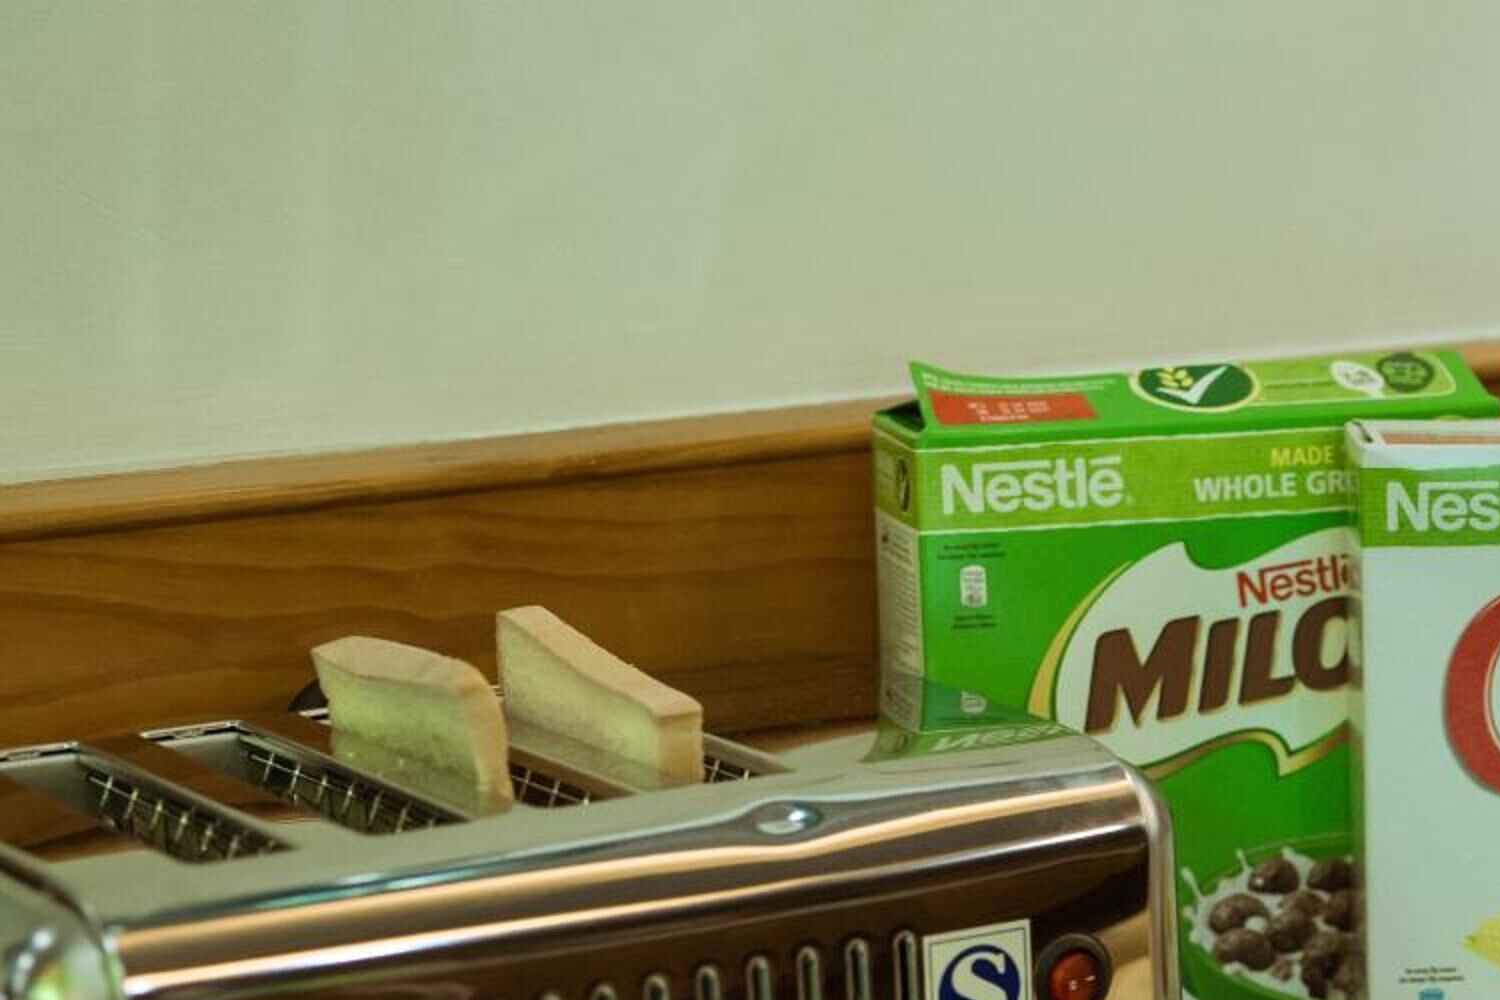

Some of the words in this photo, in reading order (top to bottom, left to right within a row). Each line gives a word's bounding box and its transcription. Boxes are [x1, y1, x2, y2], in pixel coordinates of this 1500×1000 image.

[1270, 446, 1336, 467] MADE
[940, 455, 1123, 515] Nestlé
[1193, 472, 1297, 502] WHOLE
[1084, 596, 1360, 735] MILO
